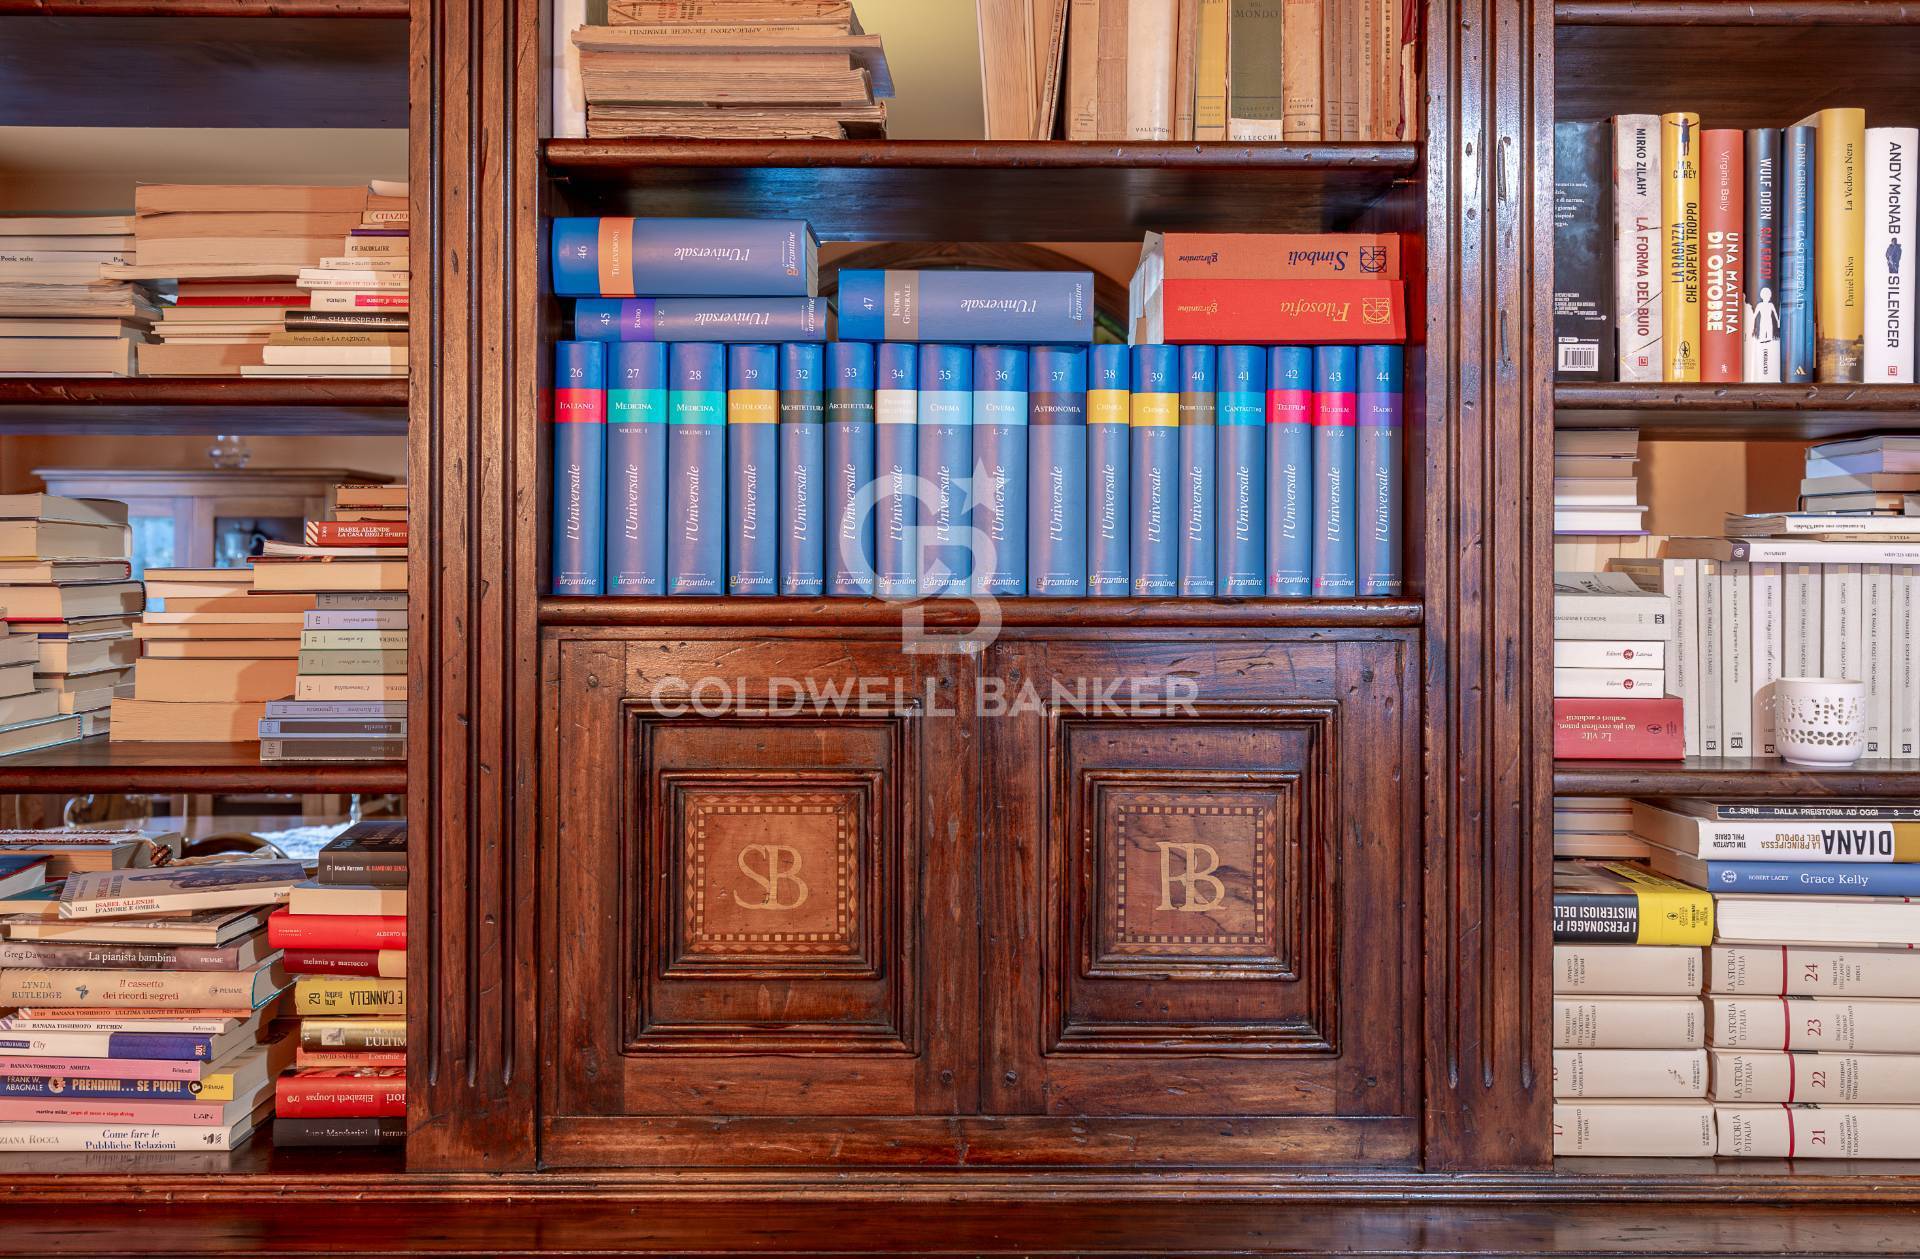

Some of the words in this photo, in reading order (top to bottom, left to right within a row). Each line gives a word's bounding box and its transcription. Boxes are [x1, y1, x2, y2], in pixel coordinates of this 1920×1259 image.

[1636, 128, 1646, 159] MIRKO
[1796, 143, 1806, 167] JOHN
[1844, 143, 1853, 168] Nera
[1889, 142, 1901, 181] ANDY
[1719, 151, 1731, 187] Virginia
[1760, 158, 1772, 187] WULF
[1636, 161, 1647, 197] ZILAHY
[1844, 170, 1853, 199] Vedova
[1796, 169, 1806, 214] GRISHAM
[1760, 191, 1772, 220] DORN
[1845, 201, 1853, 211] La
[1888, 184, 1901, 234] McNAB
[1636, 217, 1648, 230] LA
[1685, 202, 1698, 242] TROPPO
[1672, 222, 1684, 269] RAGAZZA
[1707, 232, 1723, 249] DI
[1726, 232, 1738, 267] UNA
[577, 245, 588, 259] 46
[673, 247, 750, 261] l'Universale
[1288, 250, 1349, 271] Simboli
[1636, 233, 1649, 278] FORMA
[1685, 243, 1698, 280] SAPEVA
[1760, 248, 1772, 280] EREDI
[1845, 256, 1854, 276] Silva
[1672, 270, 1684, 283] LA
[1796, 255, 1806, 310] FITZGERALD
[1637, 281, 1649, 304] DEL
[1685, 282, 1698, 303] CHE
[1707, 255, 1723, 332] OTTOBRE
[1845, 278, 1854, 307] Daniel
[863, 297, 873, 311] 47
[1280, 299, 1351, 322] Filosofia
[1726, 271, 1738, 335] MATTINA
[1887, 276, 1900, 348] SILENCER
[601, 312, 611, 326] 45
[694, 312, 770, 325] l'Universale
[1637, 305, 1650, 337] BUIO
[570, 367, 583, 378] 26
[627, 368, 639, 378] 27
[689, 370, 702, 380] 28
[745, 369, 758, 379] 29
[795, 369, 808, 379] 32
[844, 367, 857, 378] 33
[891, 369, 904, 379] 34
[938, 370, 951, 380] 35
[995, 370, 1008, 380] 36
[1051, 371, 1064, 382] 37
[1103, 369, 1116, 379] 38
[1150, 372, 1163, 382] 39
[1191, 371, 1205, 381] 40
[1237, 371, 1249, 381] 41
[1285, 369, 1298, 379] 42
[1328, 371, 1342, 381] 43
[1376, 372, 1389, 382] 44
[1034, 404, 1081, 413] ASTRONOMIA
[567, 464, 580, 540] l'Universale
[625, 464, 639, 540] l'Universale
[685, 465, 699, 541] l'Universale
[743, 464, 757, 540] l'Universale
[793, 465, 807, 541] l'Universale
[843, 463, 856, 540] l'Universale
[991, 465, 1005, 541] l'Universale
[1101, 464, 1115, 539] l'Universale
[1189, 466, 1202, 541] l'Universale
[1283, 463, 1296, 539] l'Universale
[1327, 467, 1340, 542] l'Universale
[1375, 467, 1388, 542] l'Universale
[1761, 841, 1810, 849] PRINCIPESSA
[1821, 830, 1892, 855] DIANA
[733, 843, 809, 911] SB
[1800, 873, 1834, 884] Grace
[1839, 874, 1869, 887] Kelly
[95, 901, 121, 909] ISABEL
[1582, 906, 1637, 918] MISTERIOSI
[1567, 919, 1630, 933] PERSONAGGI
[4, 951, 24, 960] Greg
[88, 951, 101, 961] La
[102, 951, 136, 963] pianista
[138, 952, 177, 963] bambina
[1727, 950, 1736, 979] STORIA
[1737, 955, 1745, 986] D'ITALIA
[1804, 963, 1819, 982] 24
[22, 981, 52, 989] LYNDA
[127, 980, 164, 988] cassetto
[12, 991, 62, 999] RUTLEDGE
[102, 991, 116, 1000] dei
[118, 991, 148, 1000] ricordi
[150, 992, 179, 1001] segreti
[308, 992, 321, 1005] 29
[349, 990, 395, 1006] CANNELLA
[1728, 1003, 1736, 1034] STORIA
[1739, 1009, 1747, 1041] D'ITALIA
[1807, 1018, 1822, 1036] 23
[32, 1040, 46, 1050] City
[1734, 1056, 1742, 1084] STORIA
[1745, 1062, 1753, 1093] D'ITALIA
[72, 1078, 134, 1092] PRENDIMI...
[137, 1080, 150, 1092] SE
[152, 1081, 181, 1093] PUOI!
[1811, 1071, 1826, 1089] 22
[305, 1092, 335, 1103] Loupas
[336, 1094, 374, 1104] Elizabeth
[29, 1135, 59, 1144] ROCCA
[102, 1130, 130, 1139] Come
[130, 1129, 150, 1139] fare
[152, 1130, 160, 1138] le
[1733, 1114, 1742, 1146] STORIA
[1744, 1121, 1752, 1152] D'ITALIA
[1811, 1129, 1826, 1145] 21
[85, 1141, 132, 1150] Pubbliche
[134, 1141, 176, 1150] Relazioni
